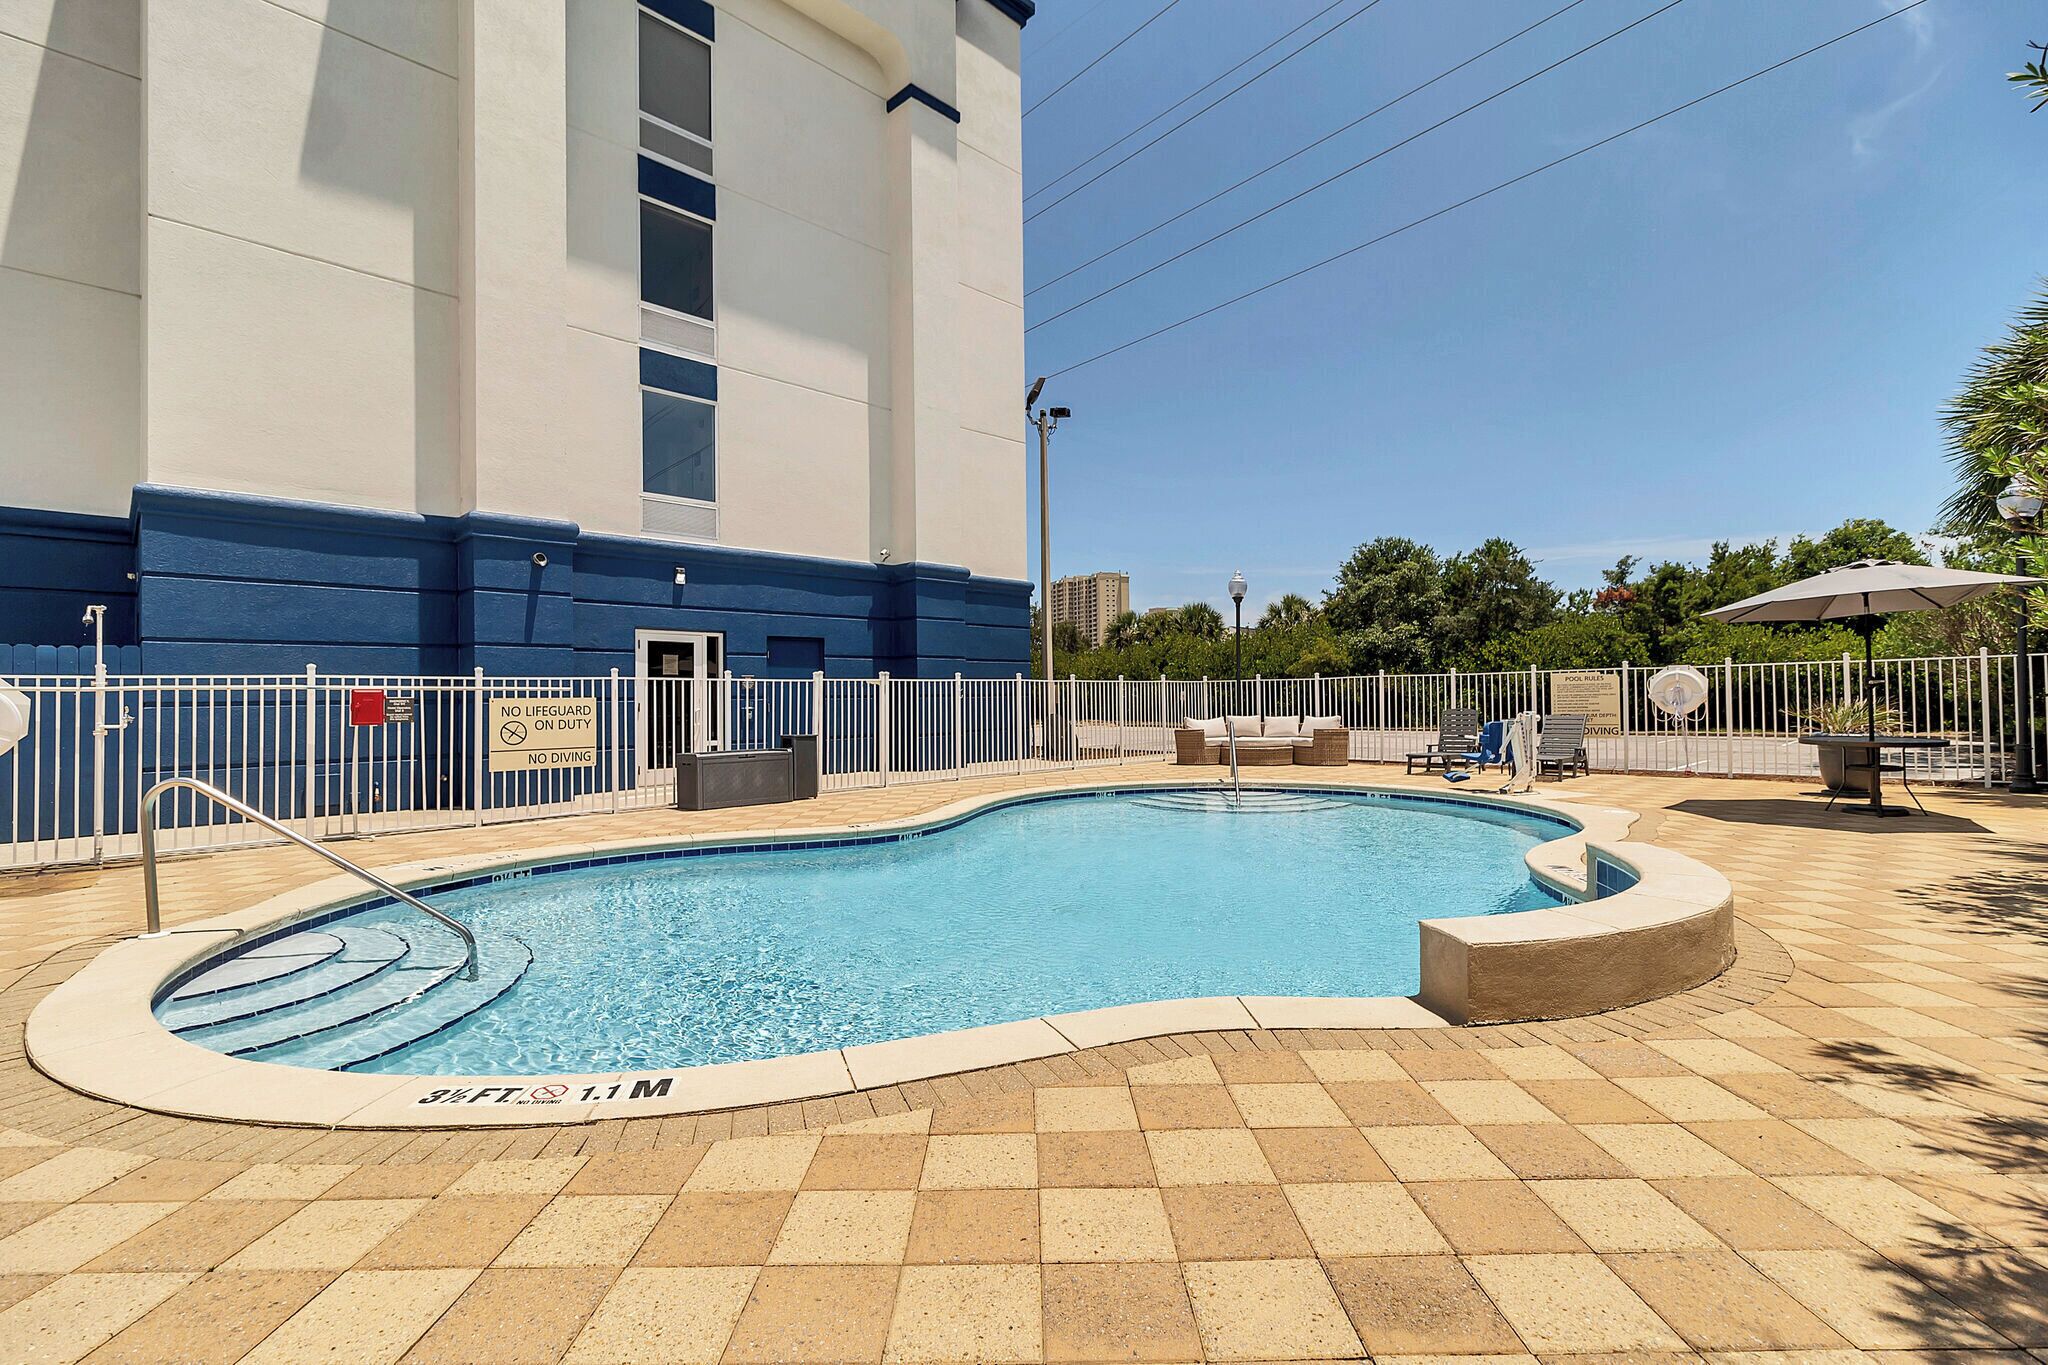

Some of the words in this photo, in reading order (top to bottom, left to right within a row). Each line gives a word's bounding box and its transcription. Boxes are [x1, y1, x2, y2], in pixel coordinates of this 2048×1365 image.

[501, 706, 522, 718] NO
[526, 705, 592, 717] LIFEGUARD
[534, 719, 554, 731] ON
[558, 719, 592, 730] DUTY
[1584, 726, 1619, 735] DIVING
[528, 752, 547, 764] NO
[551, 750, 592, 763] DIVING
[580, 1084, 622, 1101] 1.1
[628, 1078, 674, 1099] M
